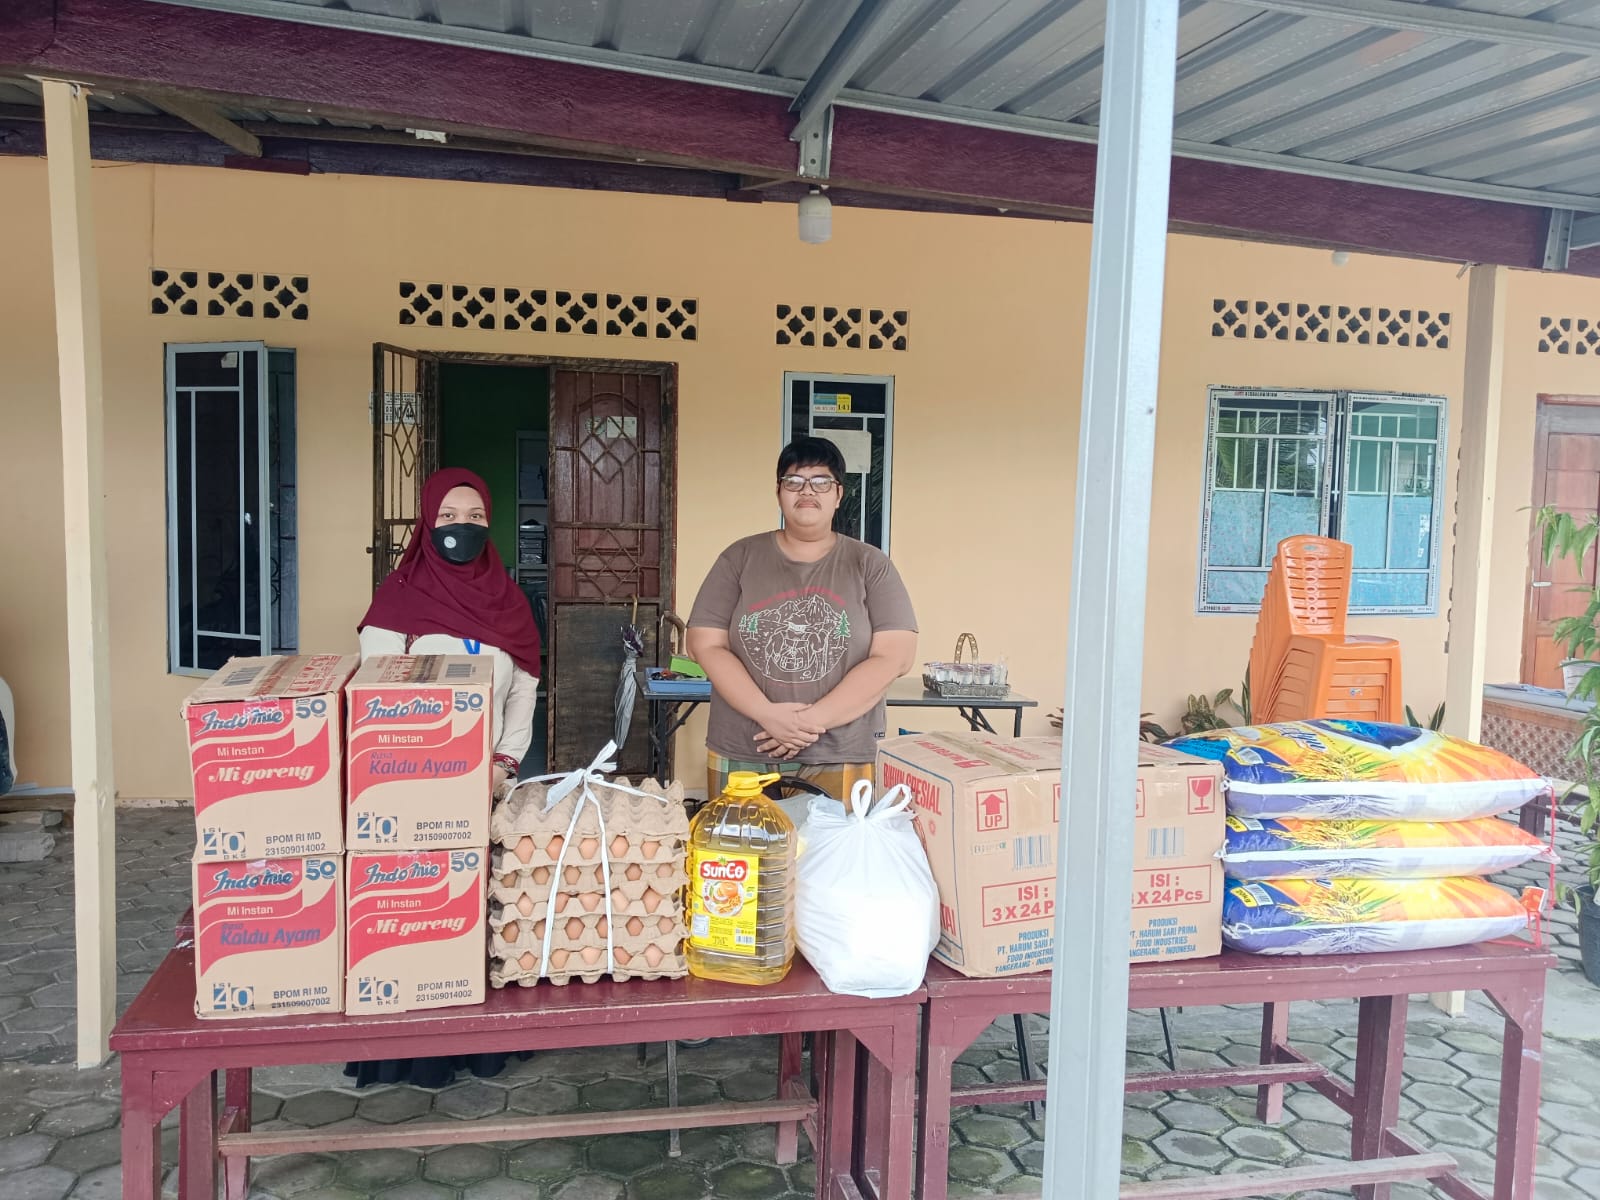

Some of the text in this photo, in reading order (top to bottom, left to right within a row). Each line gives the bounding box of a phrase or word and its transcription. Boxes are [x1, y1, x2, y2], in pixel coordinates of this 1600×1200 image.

[454, 691, 483, 712] 50
[296, 698, 327, 719] 50
[355, 696, 442, 724] Indomie
[195, 708, 285, 737] Indomie
[378, 734, 423, 743] Mi Instan
[217, 745, 265, 756] Mi Instan
[369, 758, 467, 777] Kaldu Ayam
[208, 765, 315, 784] Mi goreng
[906, 773, 942, 816] SPESIAL
[416, 820, 469, 830] BPOM RI MD
[985, 815, 1002, 828] UP
[265, 831, 322, 844] BPOM RI MD
[414, 831, 471, 842] 231509007002
[265, 843, 326, 856] 231509014002
[451, 852, 479, 872] 50
[305, 859, 336, 880] 50
[703, 862, 745, 879] SunCo
[203, 868, 293, 897] Indomie
[354, 862, 440, 891] Indomie
[1150, 874, 1170, 888] ISI
[1018, 885, 1039, 901] ISI
[1137, 892, 1149, 904] X
[1151, 890, 1172, 904] 24
[1174, 888, 1204, 901] Pcs
[377, 899, 421, 909] Mi Instan
[227, 906, 273, 916] Mi Instan
[992, 908, 1002, 922] 3
[1005, 906, 1017, 920] X
[1020, 902, 1041, 918] 24
[367, 917, 467, 936] Mi goreng
[1149, 917, 1178, 928] PRODUKSI
[220, 927, 321, 947] Kaldu Ayam
[1018, 929, 1048, 941] PRODUKSI
[1163, 927, 1177, 936] SARI
[1178, 925, 1197, 935] PRIMA
[1034, 939, 1048, 949] SARI
[1136, 936, 1188, 948] FOOD INDUSTRIES
[1165, 944, 1196, 954] INDONESIA
[1007, 953, 1023, 963] FOOD
[995, 960, 1031, 973] TANGERANG
[417, 979, 469, 991] BPOM RI MD
[273, 986, 328, 999] BPOM RI MD
[416, 990, 472, 1002] 231509014002
